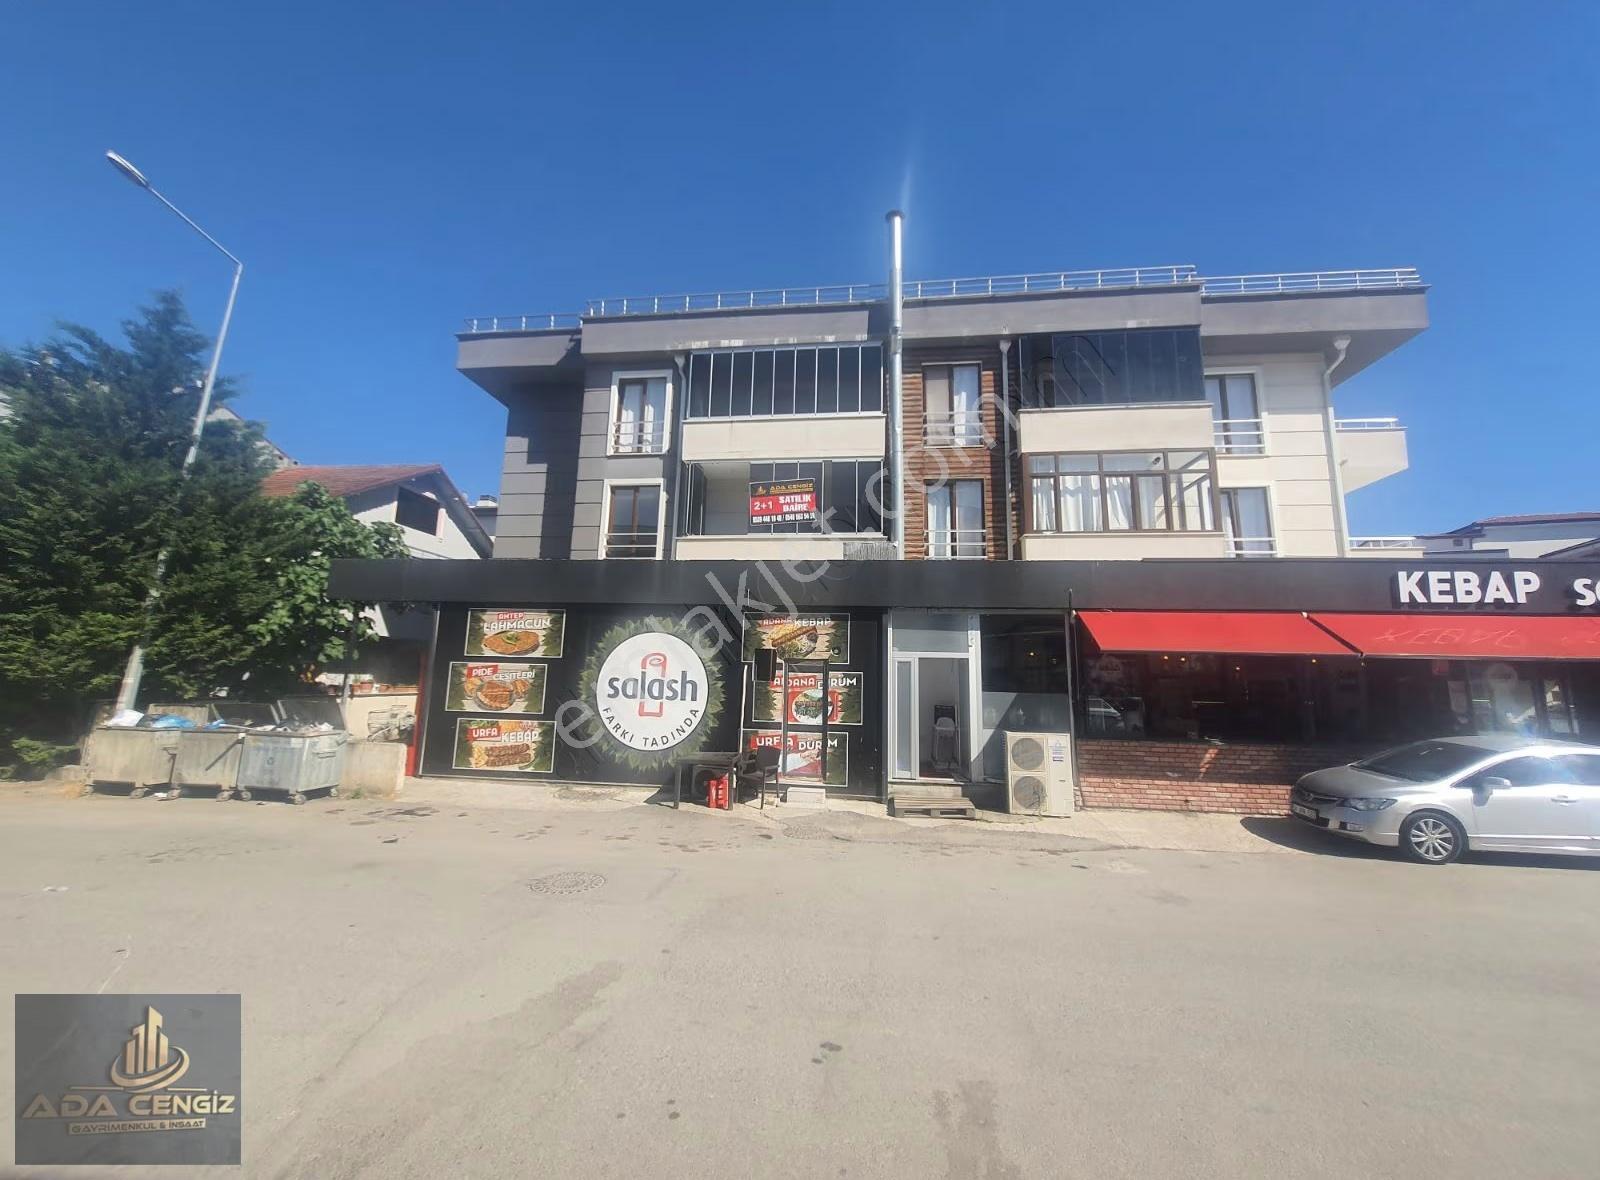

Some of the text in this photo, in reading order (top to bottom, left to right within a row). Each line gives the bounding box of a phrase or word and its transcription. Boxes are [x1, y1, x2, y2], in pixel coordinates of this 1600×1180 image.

[754, 501, 772, 510] 2+1
[779, 494, 811, 503] SATILIK
[1397, 571, 1541, 604] KEBAP
[1573, 578, 1600, 606] S
[484, 619, 551, 631] LAHMACUN
[794, 617, 832, 627] KEBAP
[607, 670, 698, 702] salash
[818, 674, 857, 689] DRÜM
[602, 707, 700, 747] FARKI TADINDA
[473, 728, 540, 742] URFA KEBAP
[798, 738, 838, 750] DÜRM
